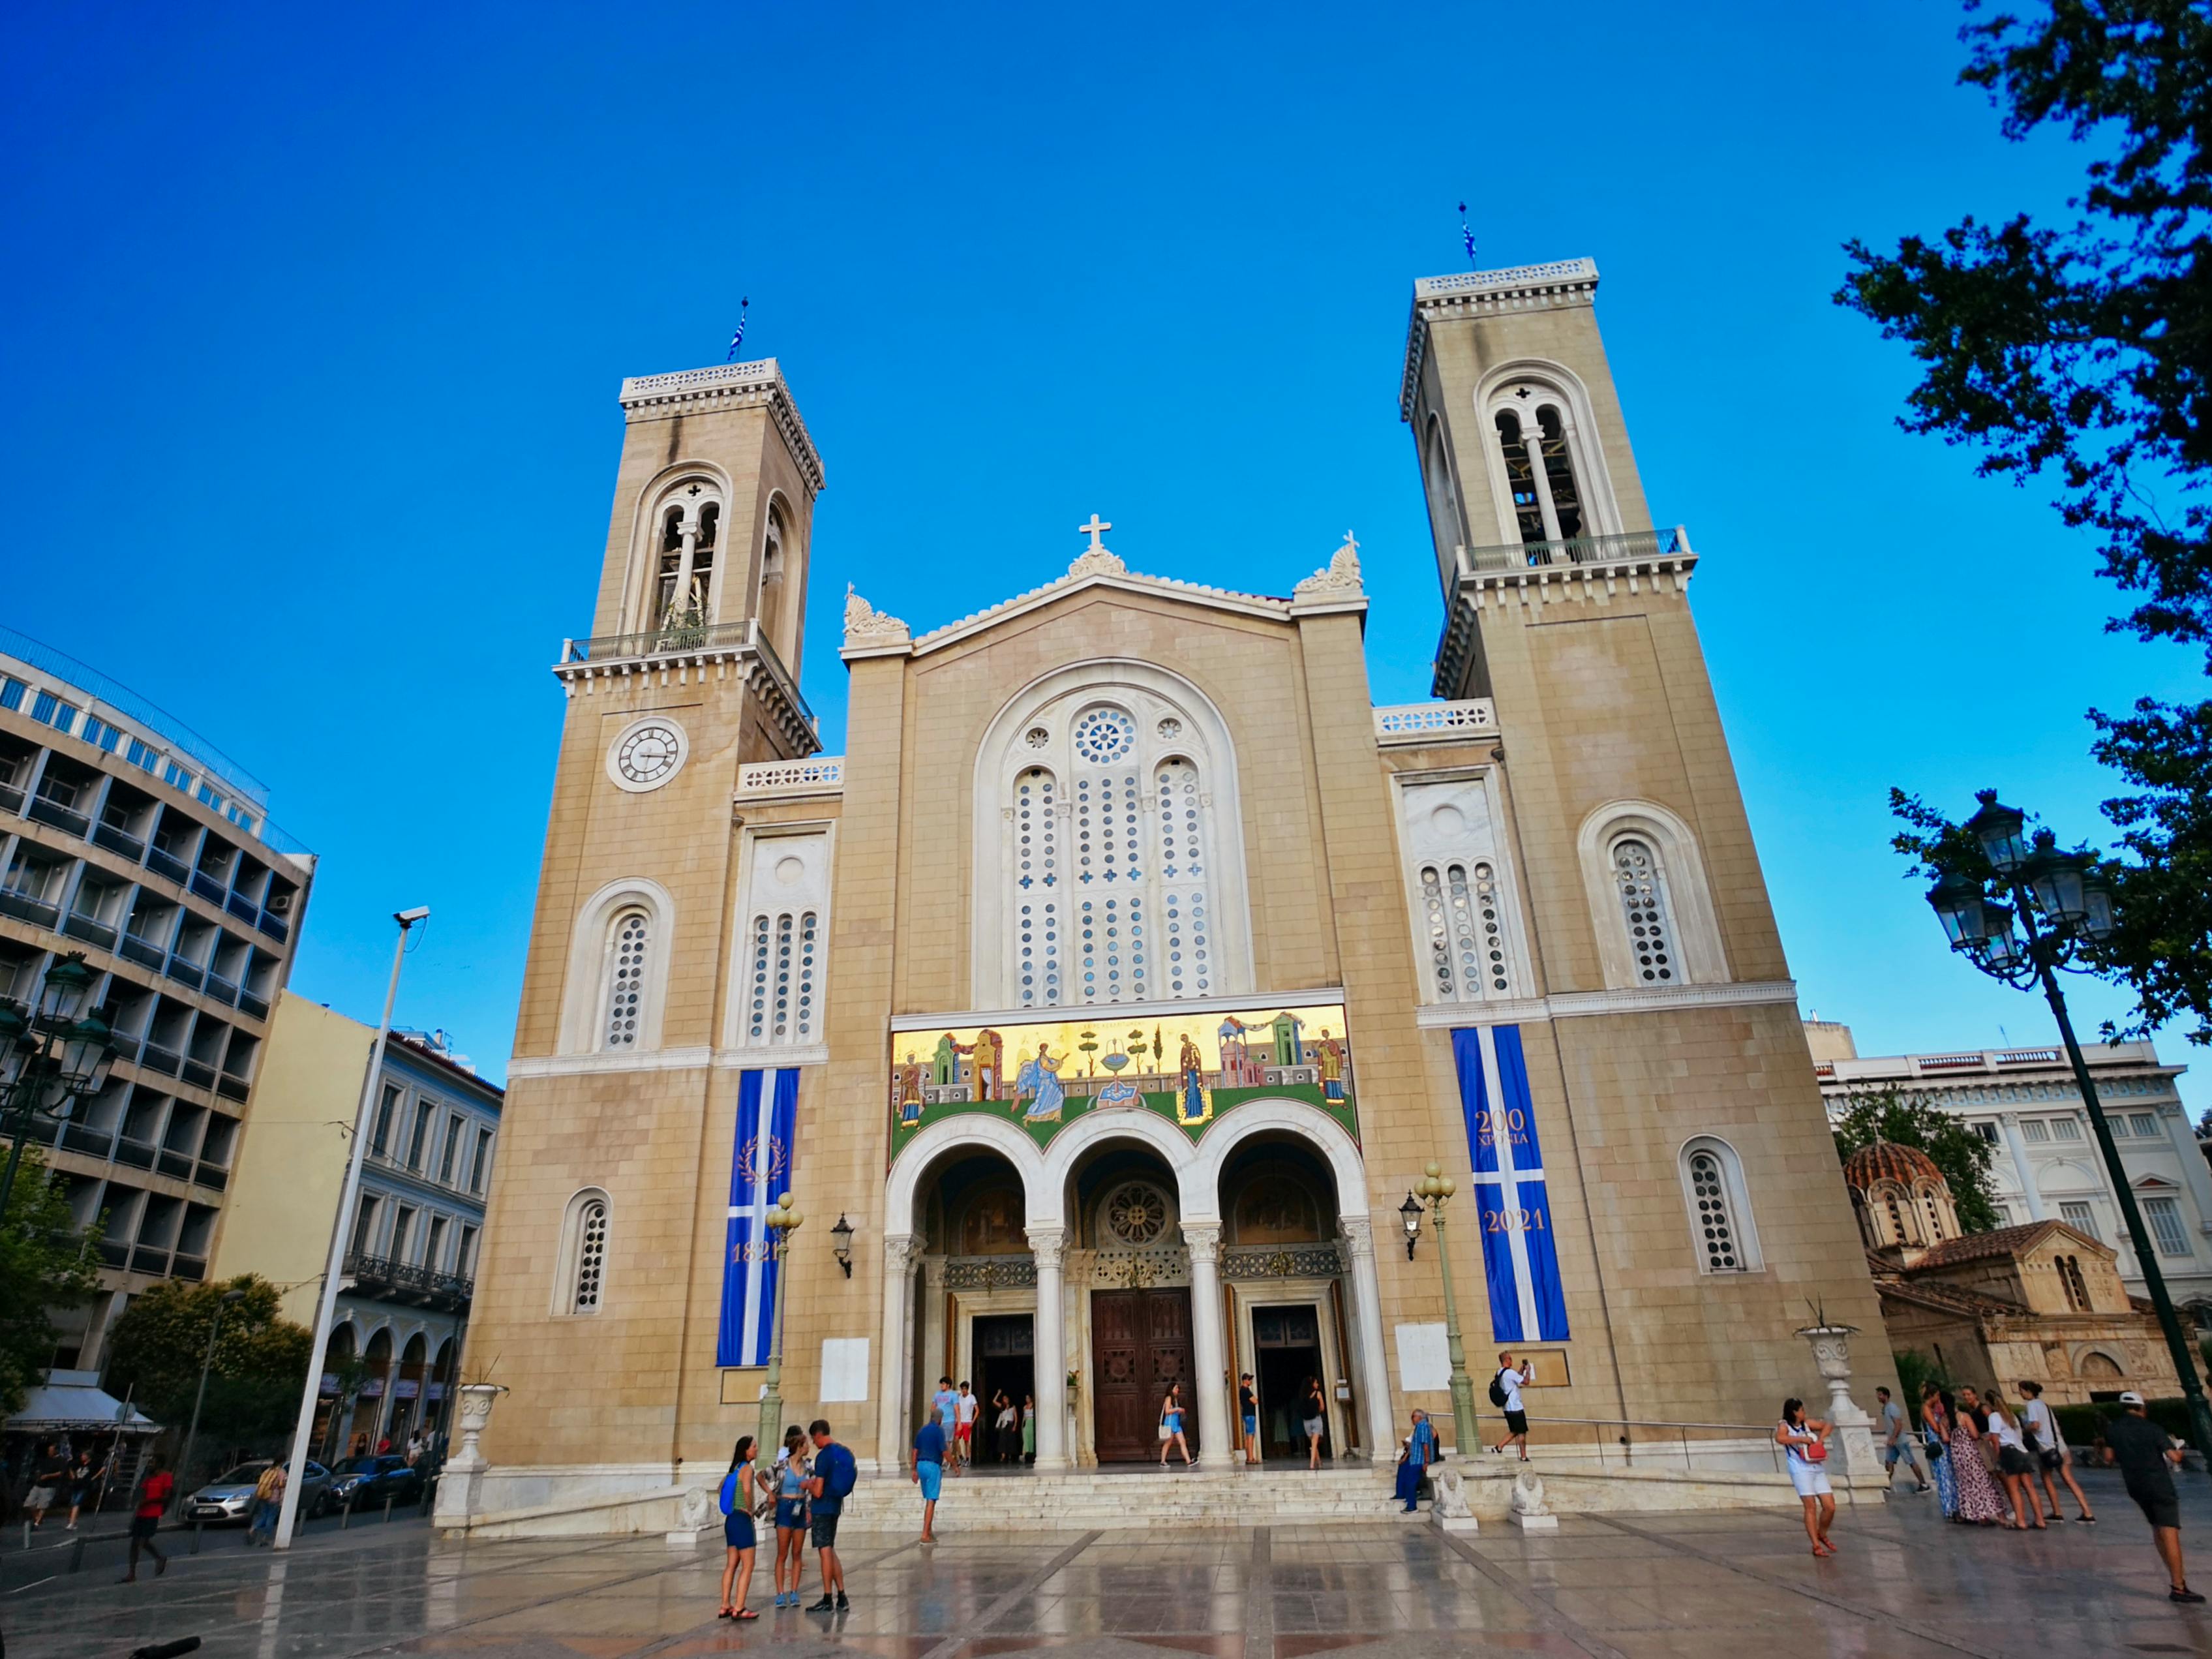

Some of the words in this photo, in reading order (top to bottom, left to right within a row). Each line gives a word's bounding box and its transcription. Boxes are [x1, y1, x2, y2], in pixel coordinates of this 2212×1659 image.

[1475, 1108, 1524, 1133] 200
[1484, 1208, 1545, 1232] 2021
[733, 1241, 778, 1263] 1821
